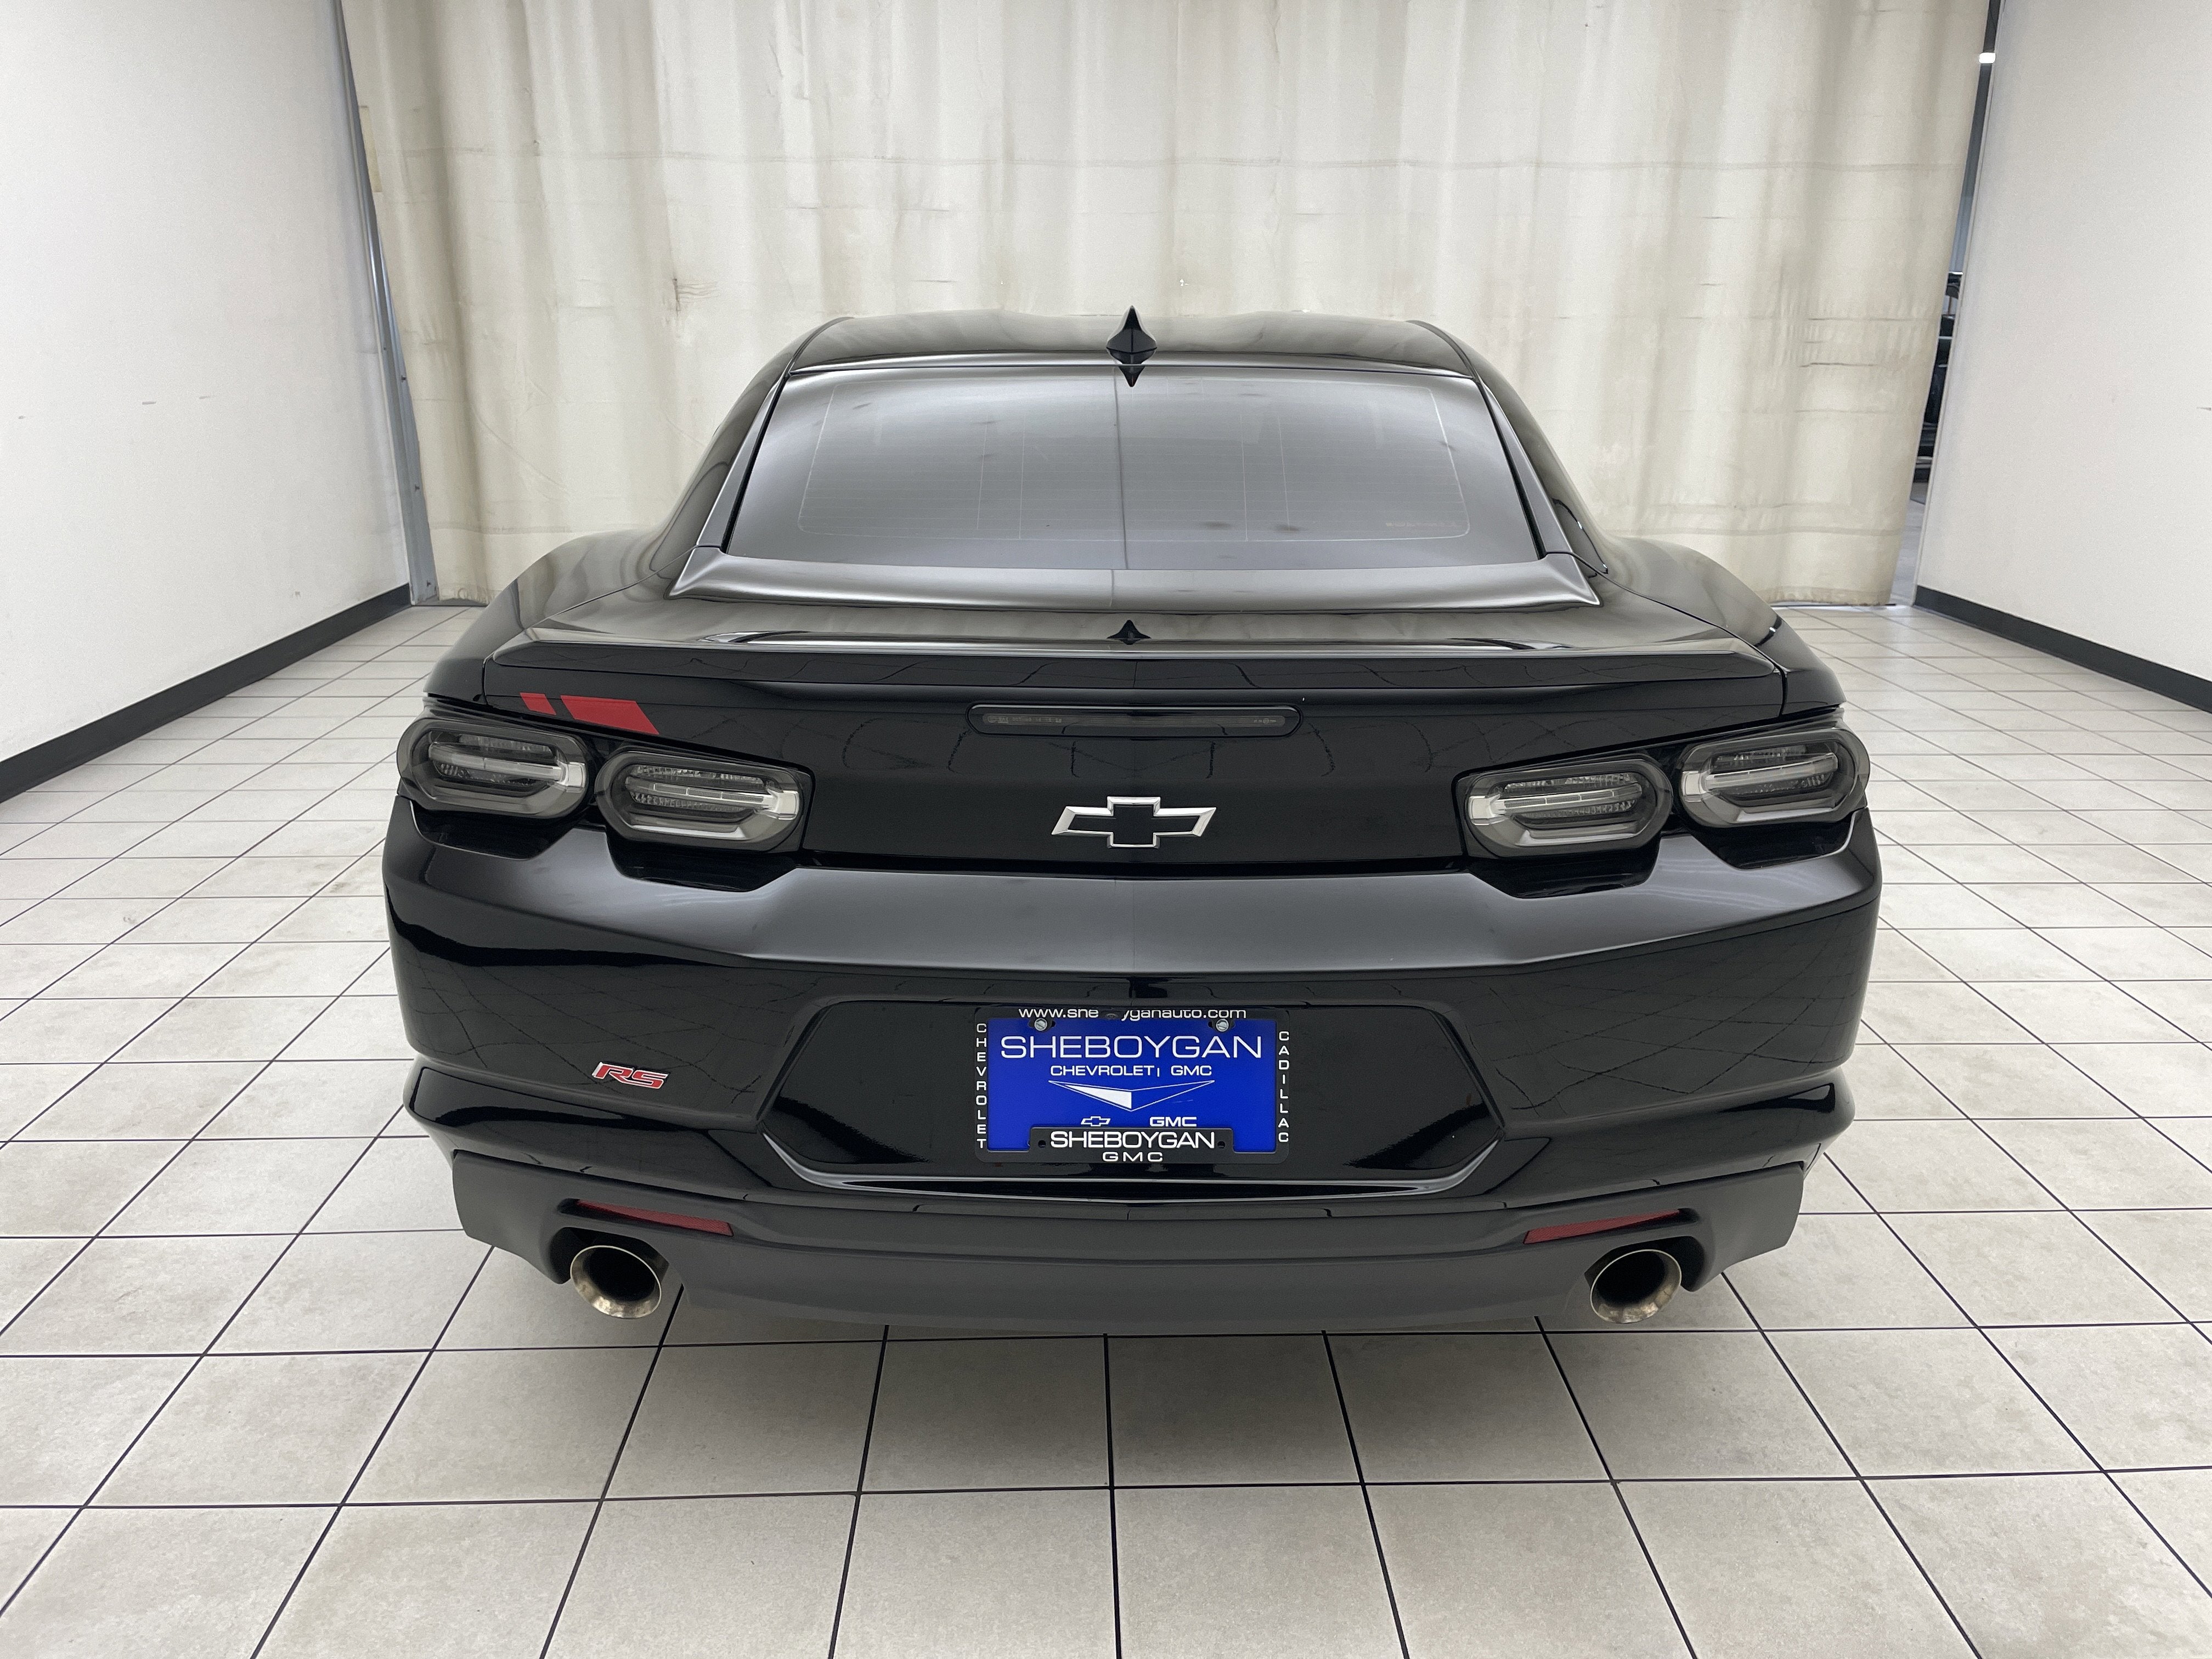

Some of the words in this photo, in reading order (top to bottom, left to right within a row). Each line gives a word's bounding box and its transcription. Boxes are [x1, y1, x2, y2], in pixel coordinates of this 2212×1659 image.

[1001, 1035, 1261, 1058] SHEBOYGAN
[591, 1062, 669, 1089] RS
[1050, 1065, 1155, 1076] CHEVROLET
[1171, 1065, 1212, 1076] GMC
[975, 1023, 987, 1149] CHEVROLET
[1278, 1031, 1290, 1142] CADILLAC
[1149, 1116, 1197, 1127] GMC
[1051, 1131, 1215, 1149] SHEBOYGAN
[1102, 1152, 1163, 1162] GMC
